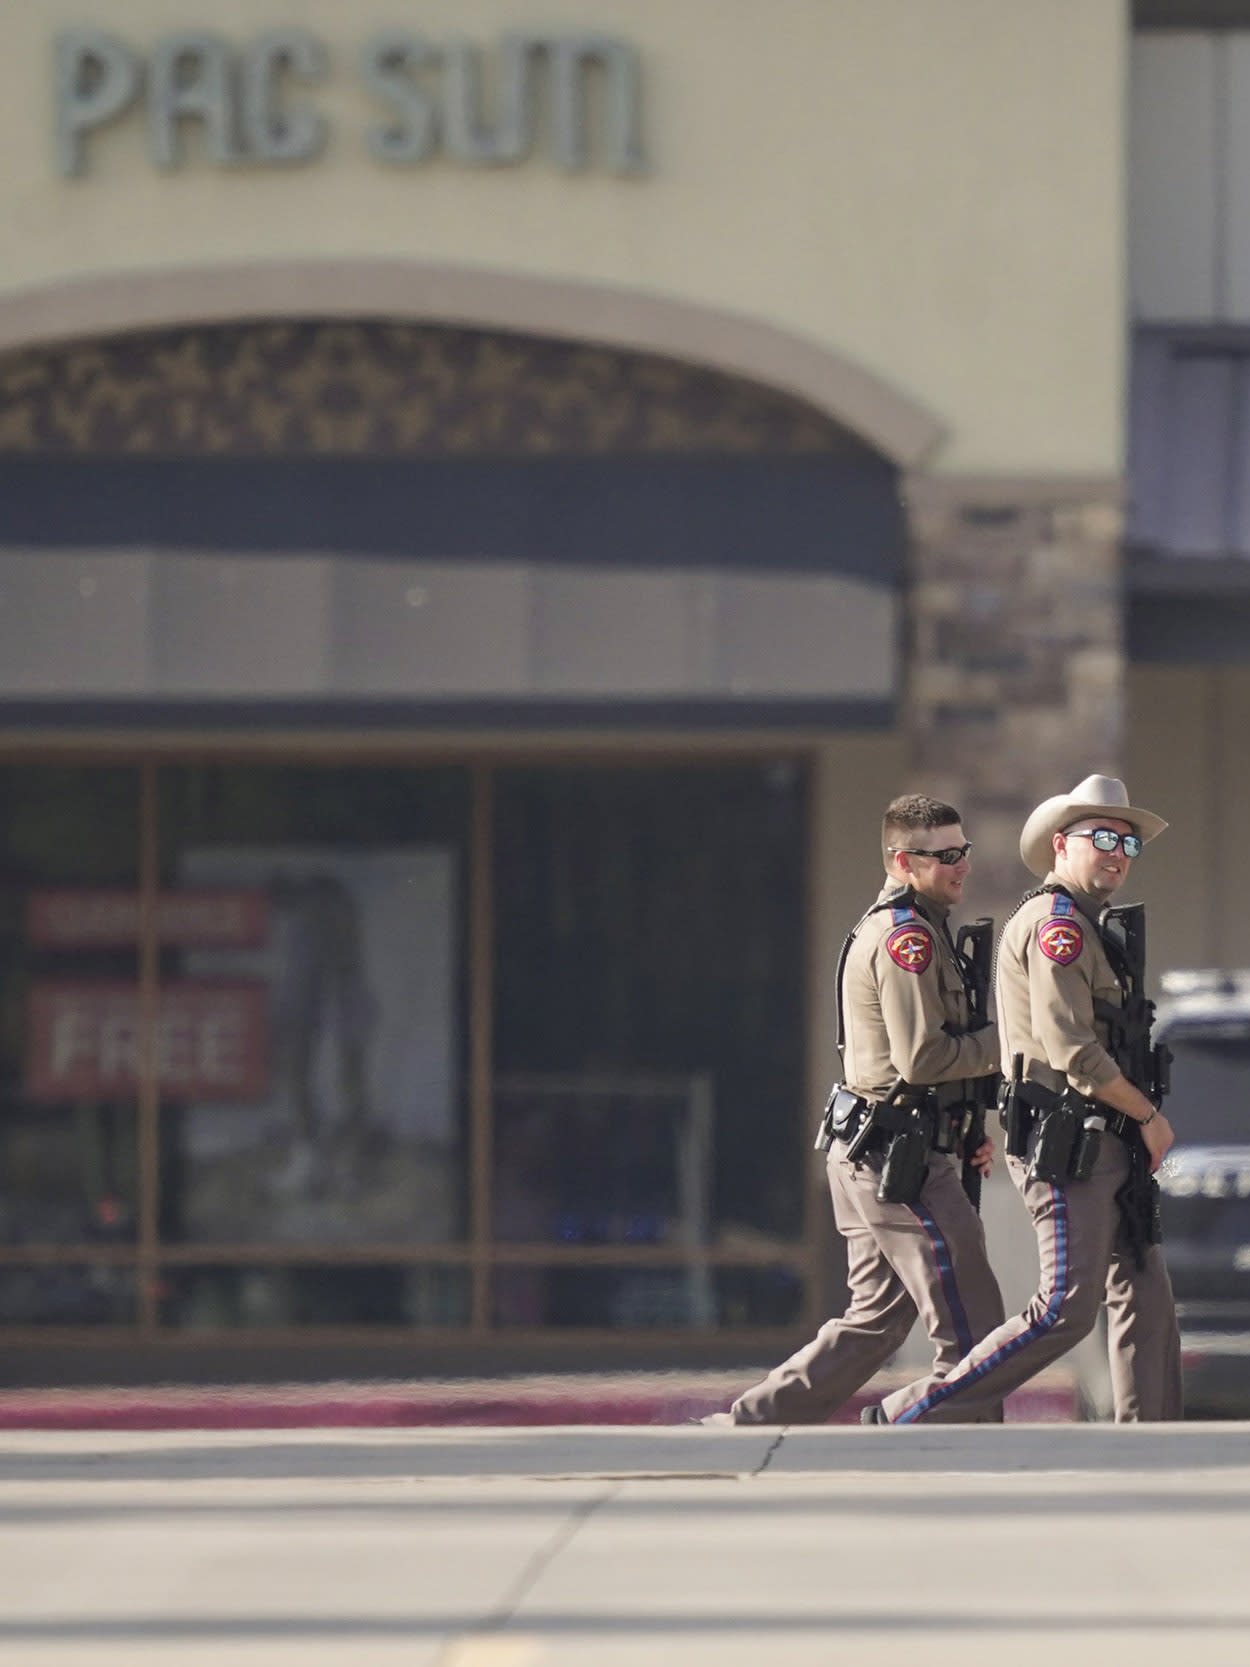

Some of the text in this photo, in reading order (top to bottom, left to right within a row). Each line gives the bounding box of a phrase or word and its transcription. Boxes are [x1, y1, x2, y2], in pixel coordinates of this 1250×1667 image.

[54, 29, 652, 177] PAC SUN
[51, 1006, 245, 1085] FREE
